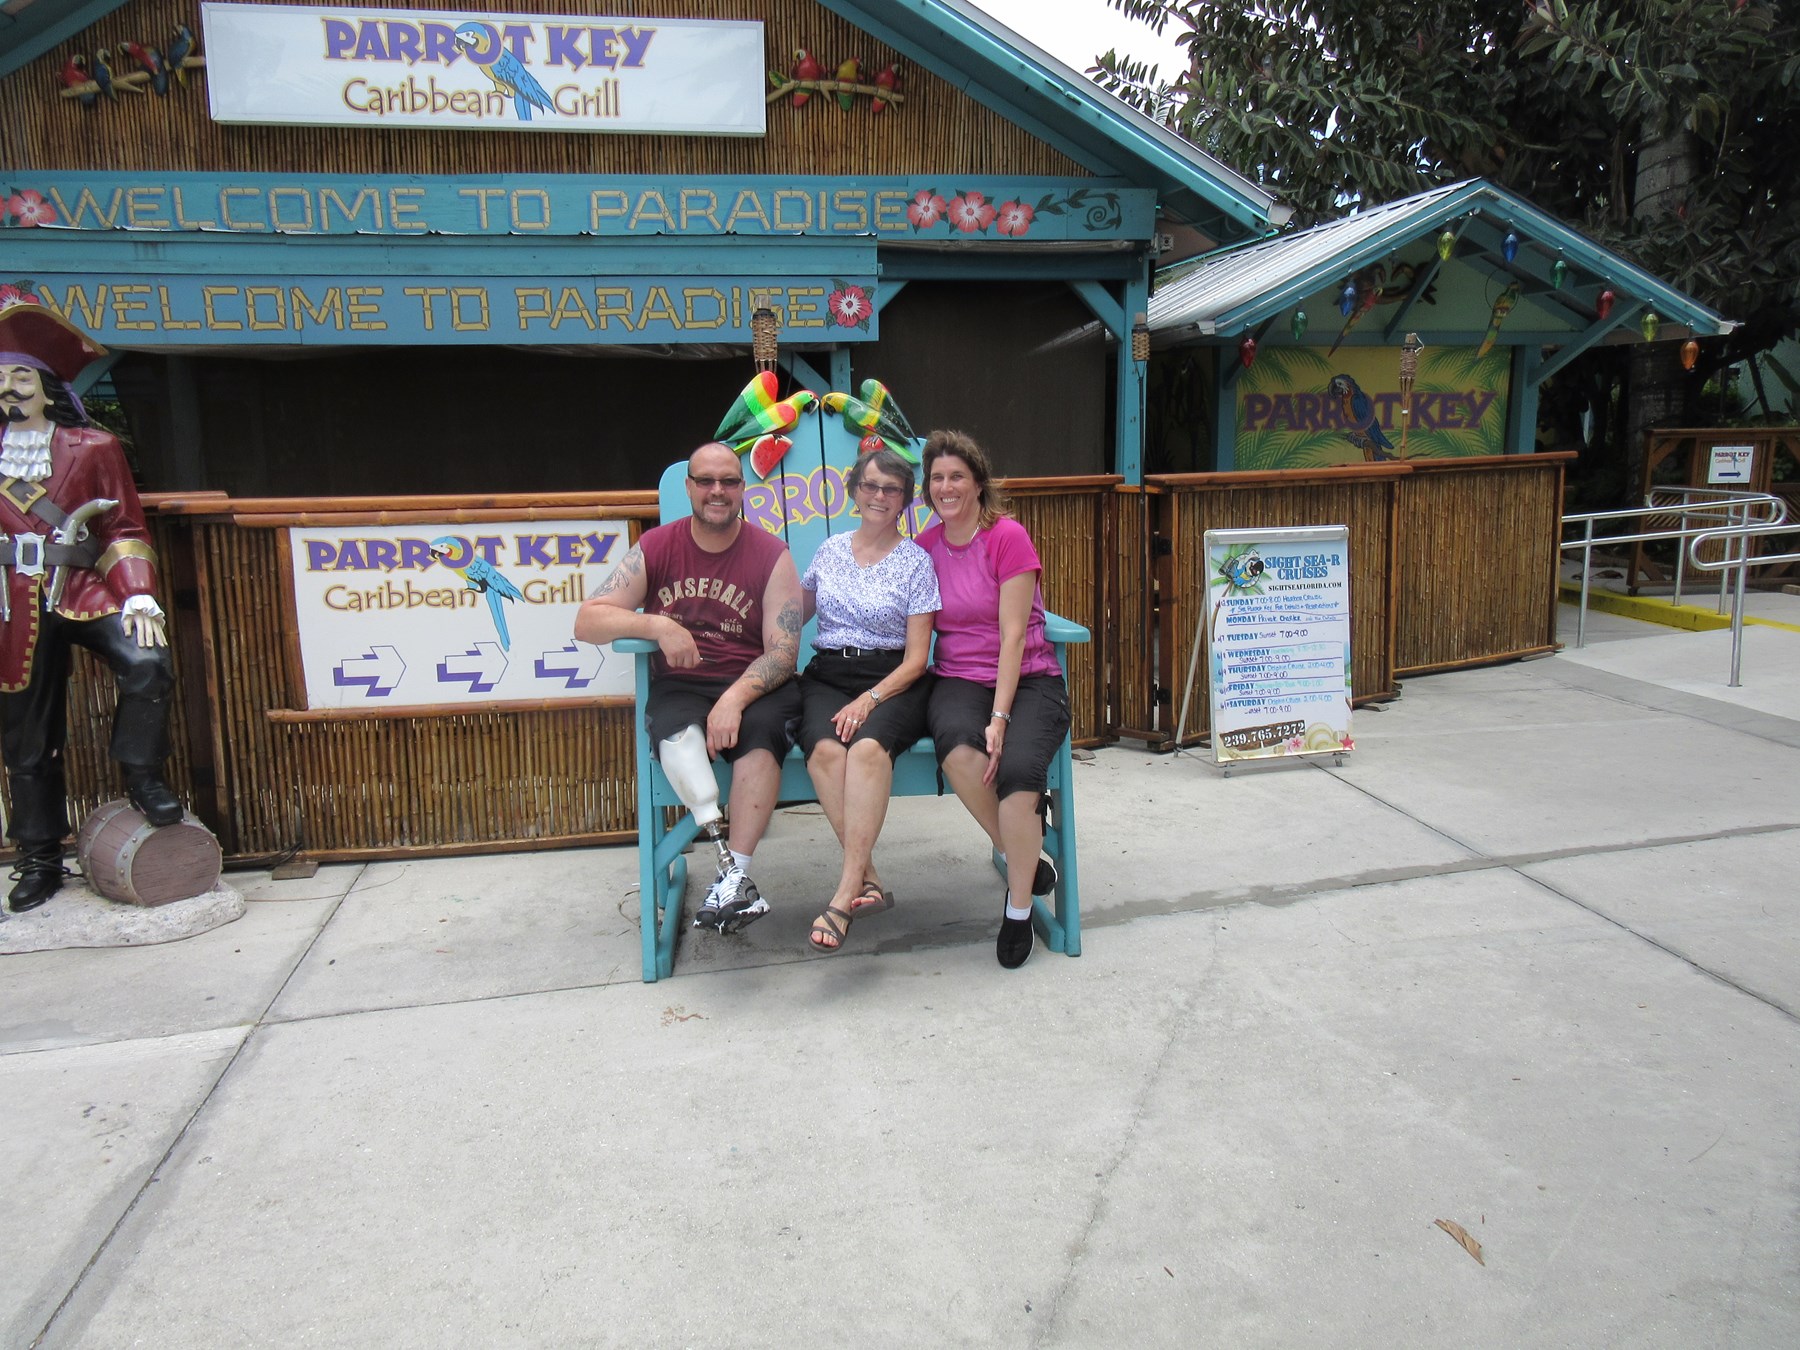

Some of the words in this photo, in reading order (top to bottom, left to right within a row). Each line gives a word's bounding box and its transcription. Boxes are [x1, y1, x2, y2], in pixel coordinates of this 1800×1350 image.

[320, 16, 534, 69] PARROT
[543, 26, 658, 70] KEY
[341, 76, 505, 119] Caribbean
[552, 86, 622, 119] Grill
[48, 185, 426, 231] WELCOME
[460, 189, 550, 230] TO
[590, 190, 909, 233] PARADISE
[39, 284, 387, 331] WELCOME
[404, 286, 488, 331] TO
[1243, 391, 1397, 432] PARROT
[1402, 389, 1497, 431] KEY
[302, 536, 505, 572] PARROT
[513, 532, 619, 569] KEY
[1264, 556, 1301, 569] SIGHT
[1304, 554, 1340, 567] SEA-R
[1277, 566, 1328, 580] CRUISES
[324, 580, 478, 612] Caribbean
[524, 574, 586, 603] Grill
[1268, 582, 1342, 592] SIGHTSEAFLORIDA.COM
[657, 577, 754, 620] BASEBALL
[1226, 598, 1254, 606] SUNDAY
[1226, 616, 1256, 624] MONDAY
[720, 622, 743, 634] 1846
[1226, 632, 1258, 642] TUESDAY
[1227, 648, 1271, 659] WEDNESDAY
[1227, 664, 1265, 675] THURSDAY
[1228, 682, 1255, 692] FRIDAY
[1229, 698, 1266, 708] SATURDAY
[1224, 722, 1305, 747] 239.765.7272
